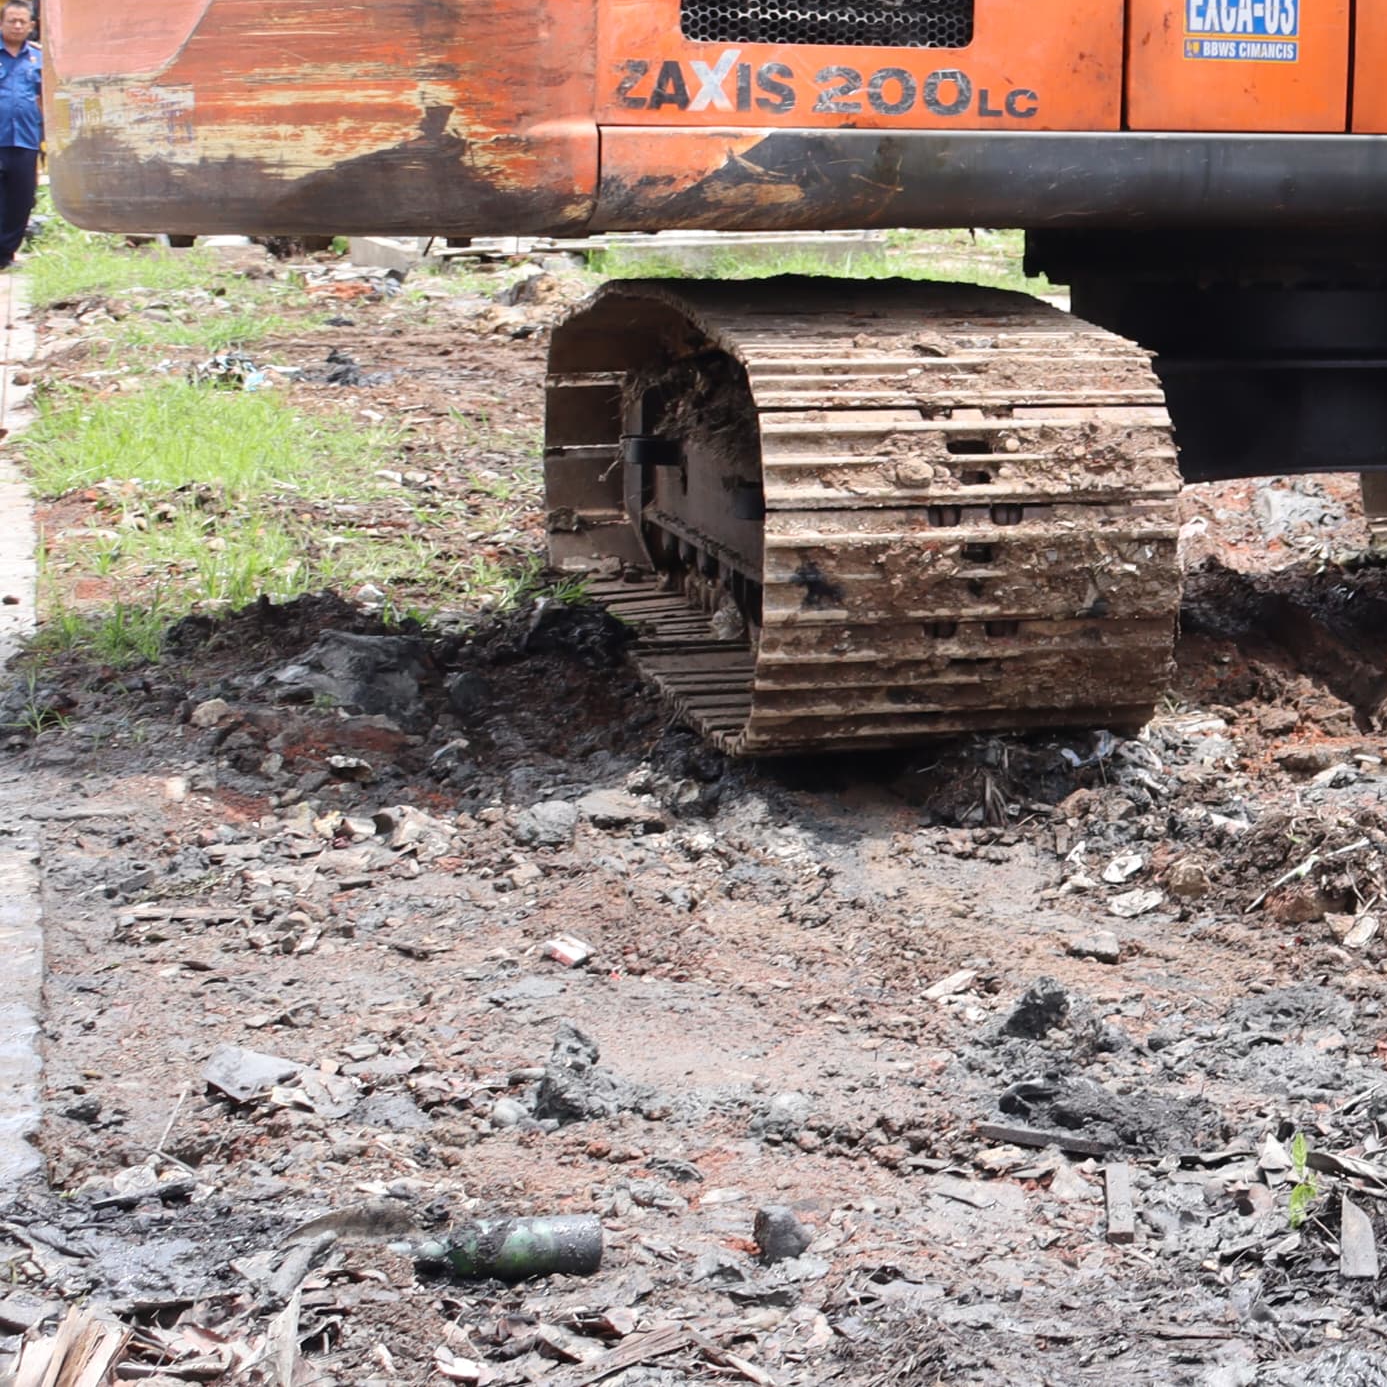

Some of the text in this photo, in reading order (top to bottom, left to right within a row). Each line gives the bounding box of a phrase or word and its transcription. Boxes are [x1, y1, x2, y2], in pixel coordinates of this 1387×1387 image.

[1202, 41, 1295, 60] BBWS CIMANCIS
[611, 49, 796, 115] ZAXIS
